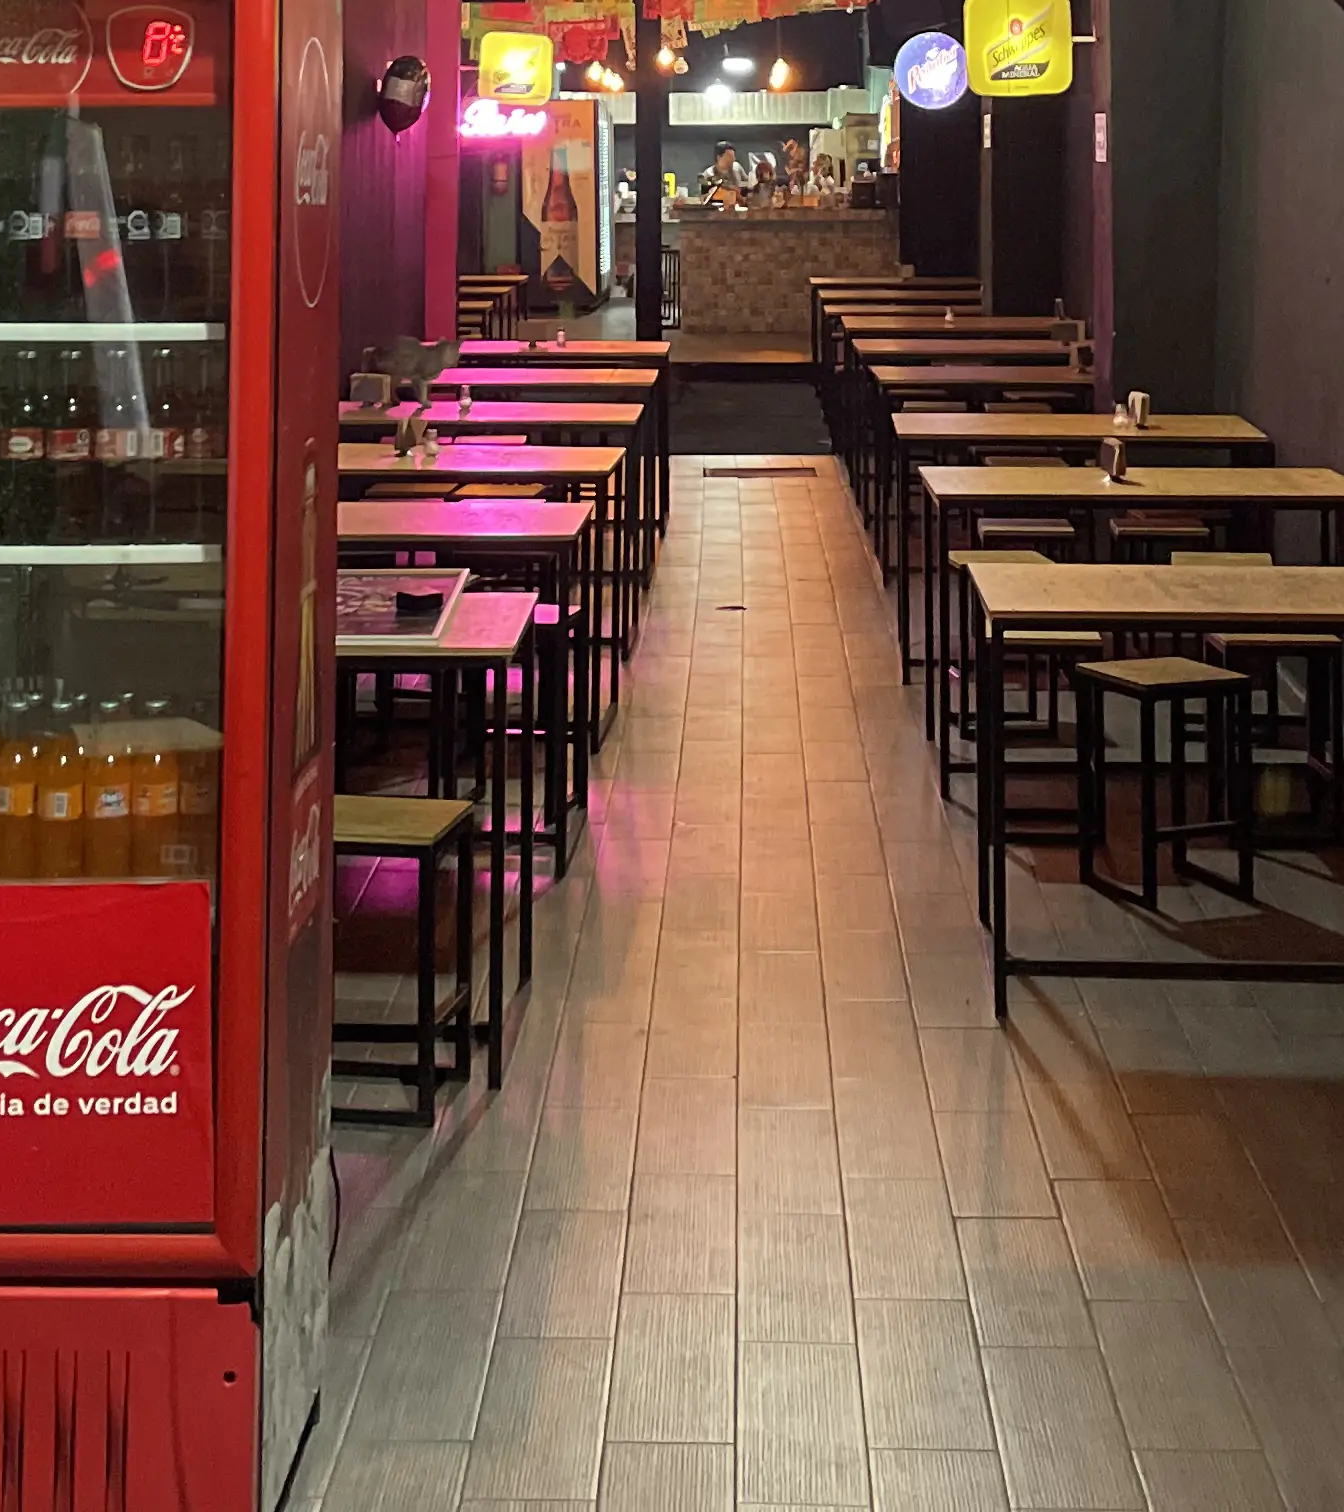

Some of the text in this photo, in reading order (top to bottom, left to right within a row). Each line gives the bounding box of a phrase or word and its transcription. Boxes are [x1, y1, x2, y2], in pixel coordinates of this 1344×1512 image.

[992, 22, 1047, 69] Schwppes
[33, 1092, 71, 1116] de
[77, 1090, 178, 1116] verdad
